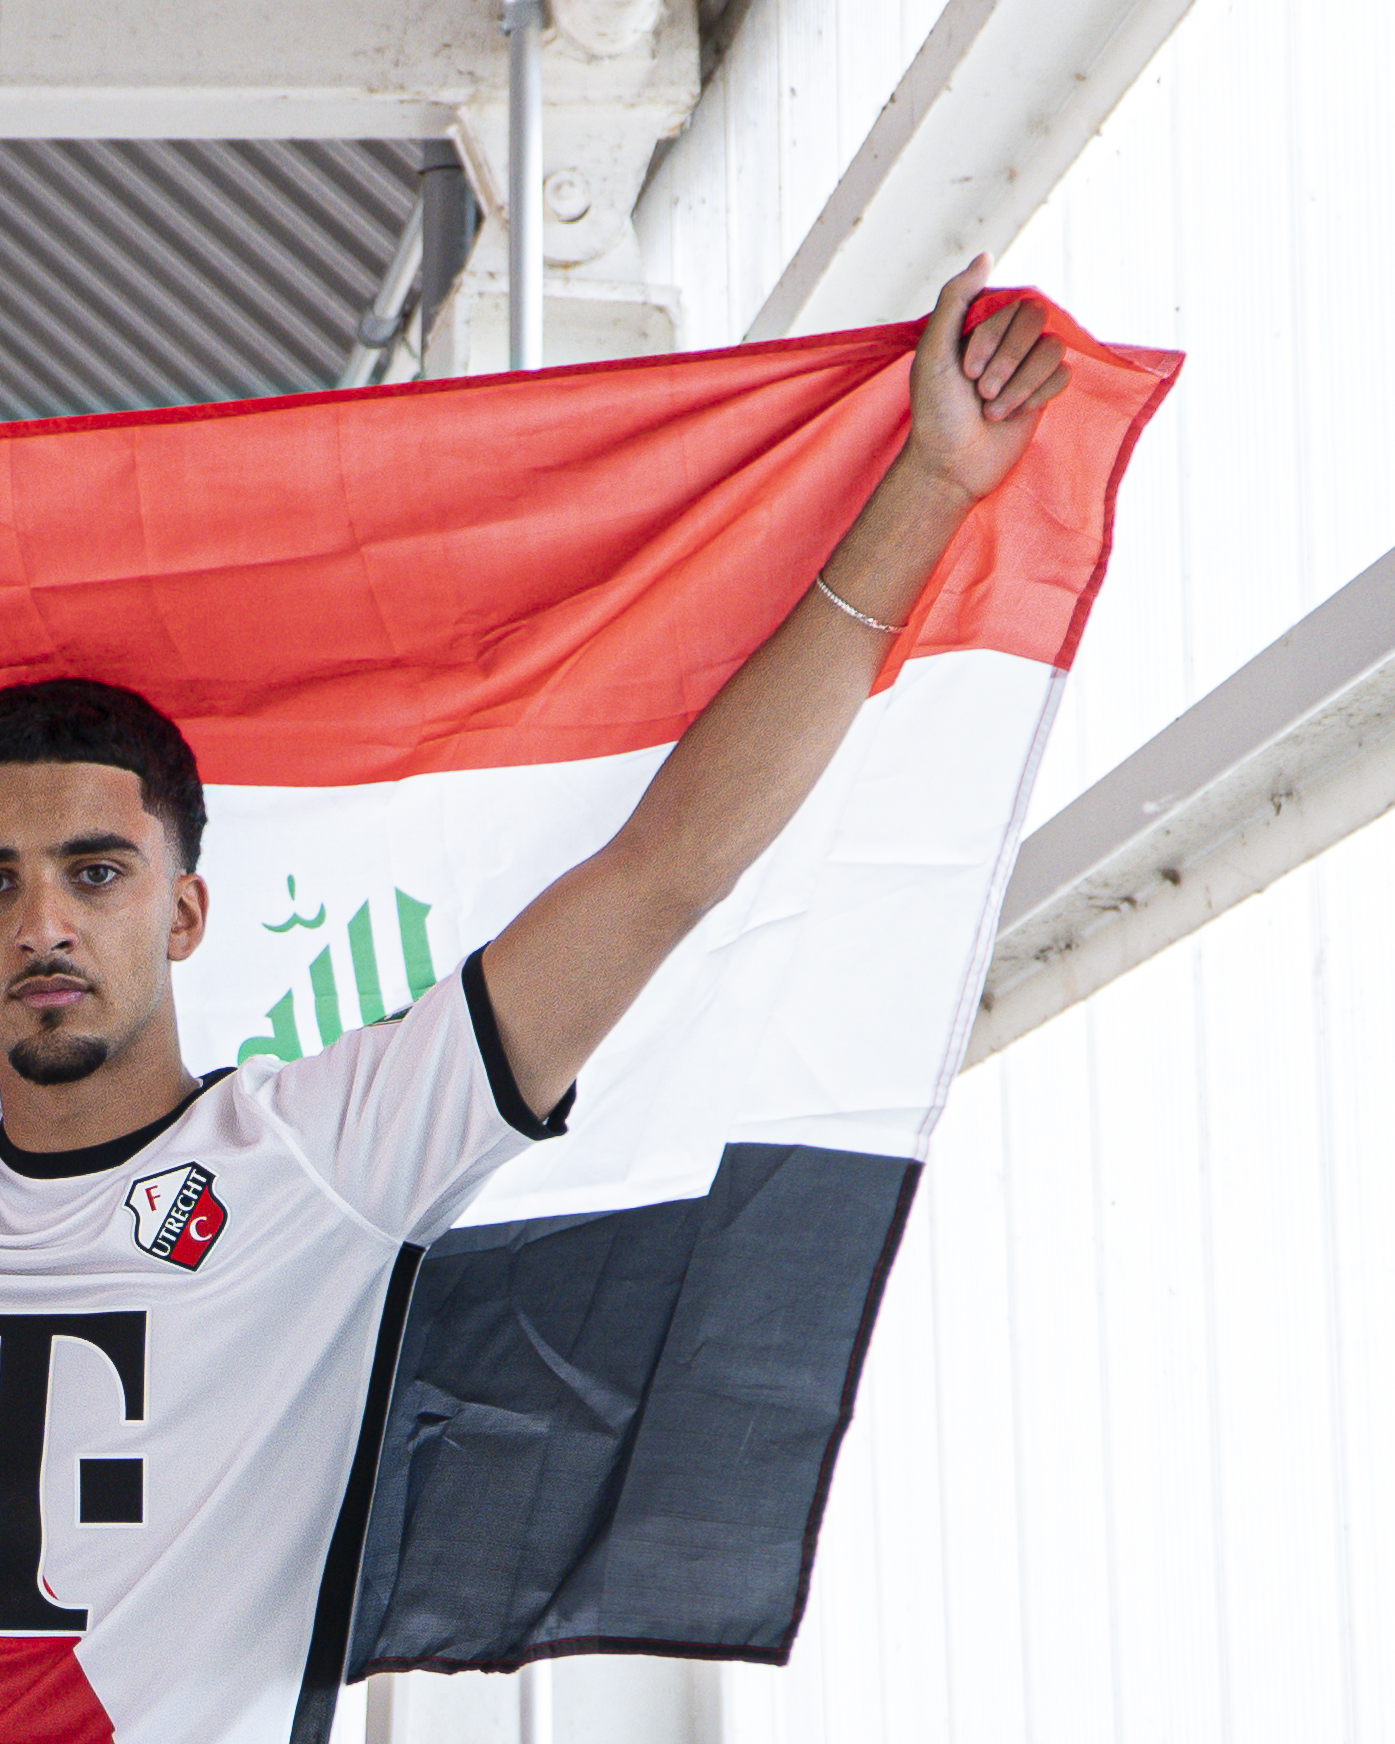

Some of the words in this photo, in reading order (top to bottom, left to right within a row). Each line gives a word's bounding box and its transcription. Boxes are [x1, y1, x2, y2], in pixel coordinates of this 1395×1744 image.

[145, 1184, 161, 1212] F
[151, 1168, 207, 1257] UTRECHT
[189, 1215, 213, 1241] C
